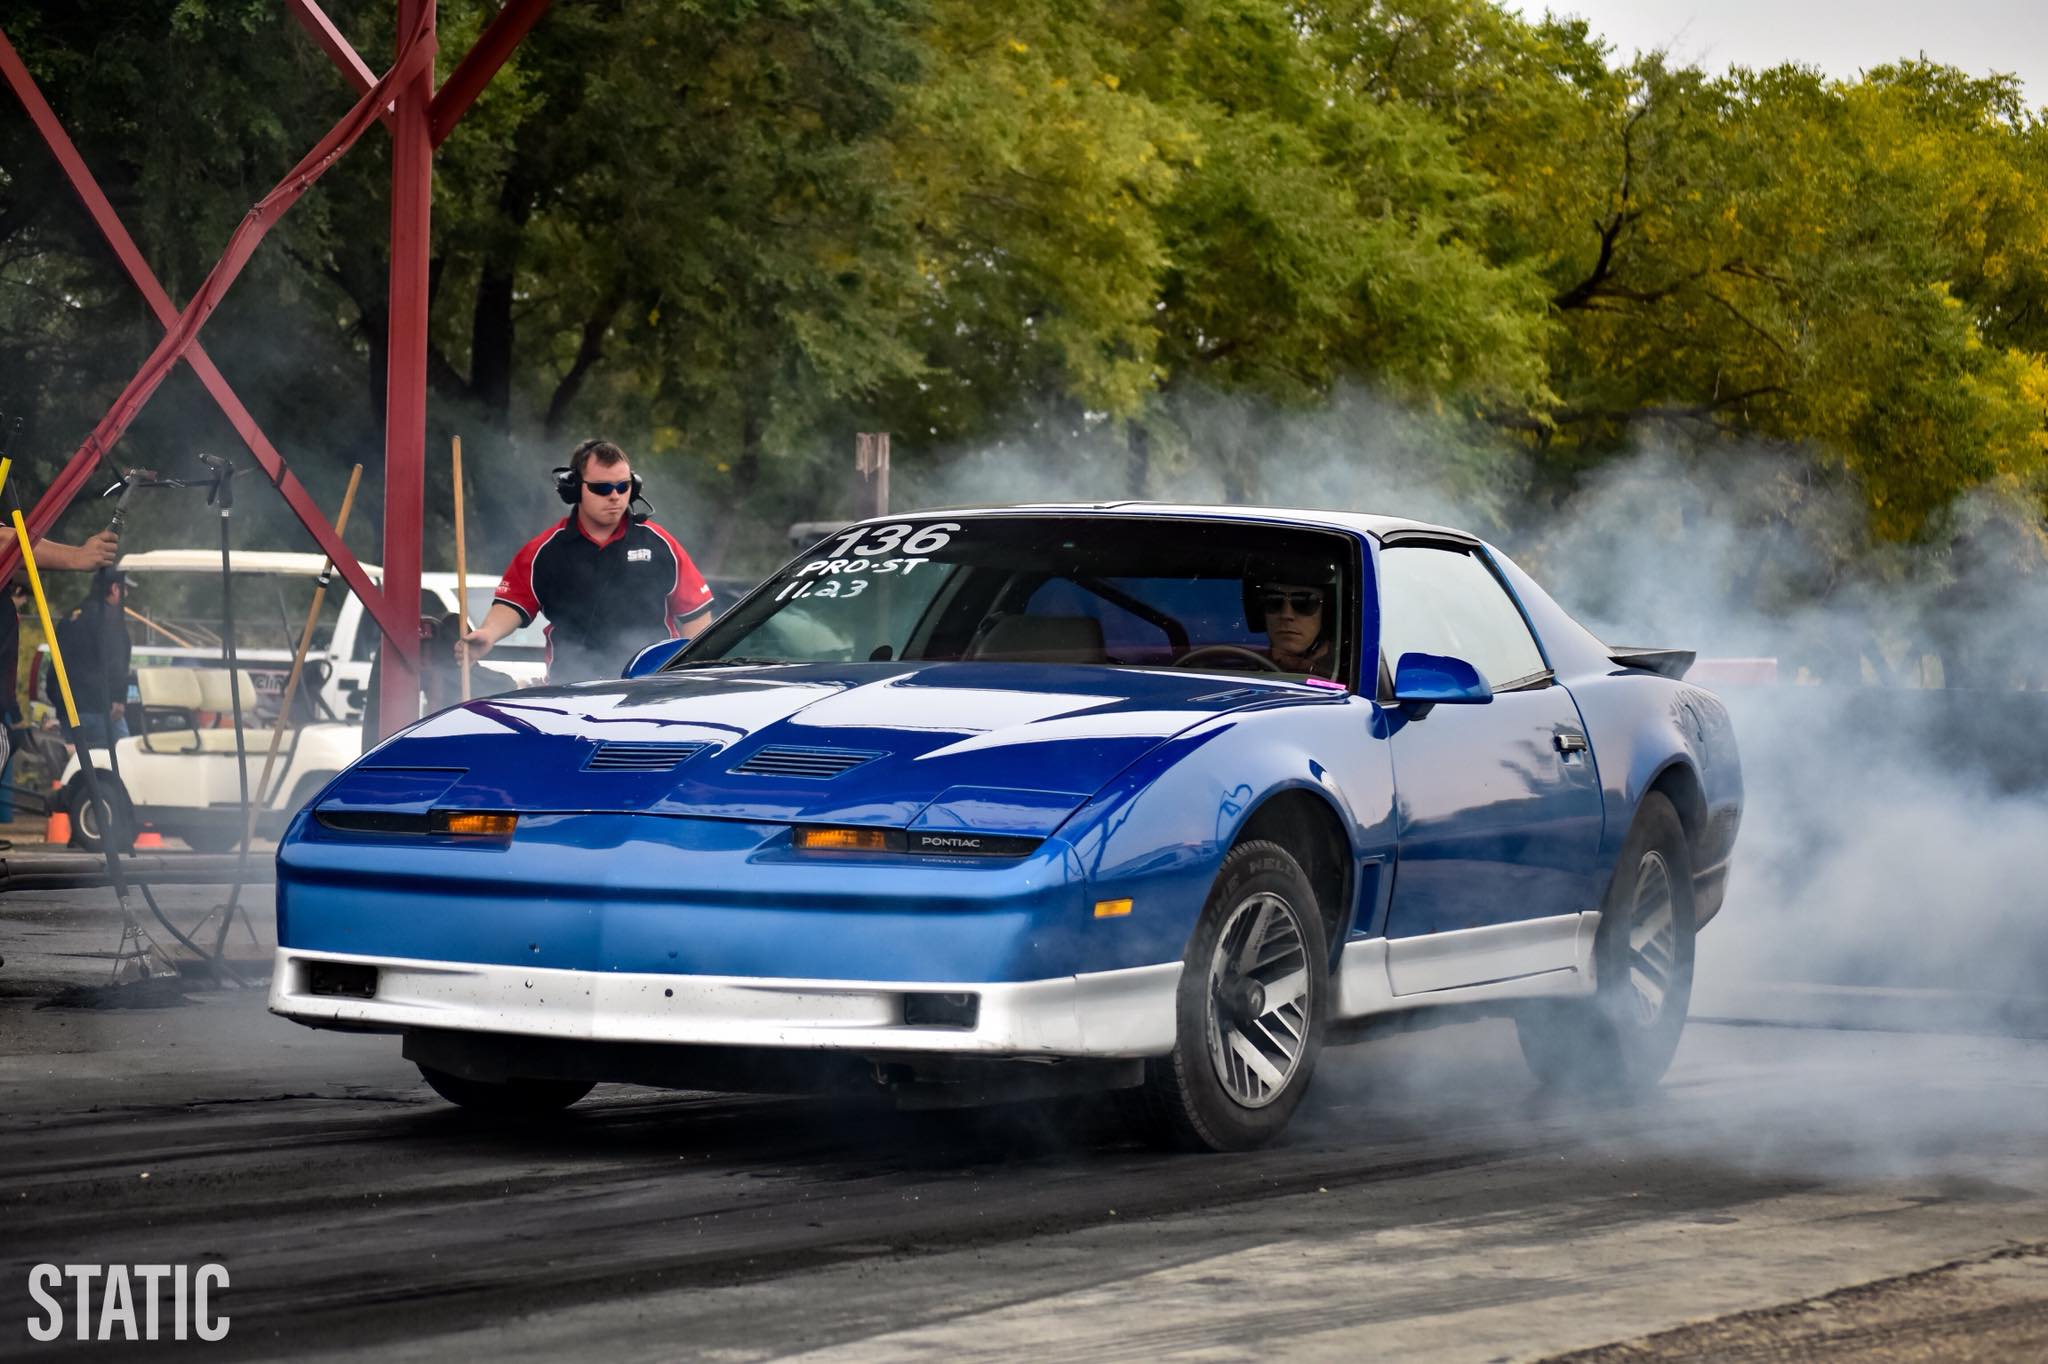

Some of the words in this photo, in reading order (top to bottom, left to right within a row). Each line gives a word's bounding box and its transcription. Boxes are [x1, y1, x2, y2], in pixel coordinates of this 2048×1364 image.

[829, 523, 961, 558] 136
[775, 580, 869, 601] 11.23
[922, 837, 980, 848] PONTIAC
